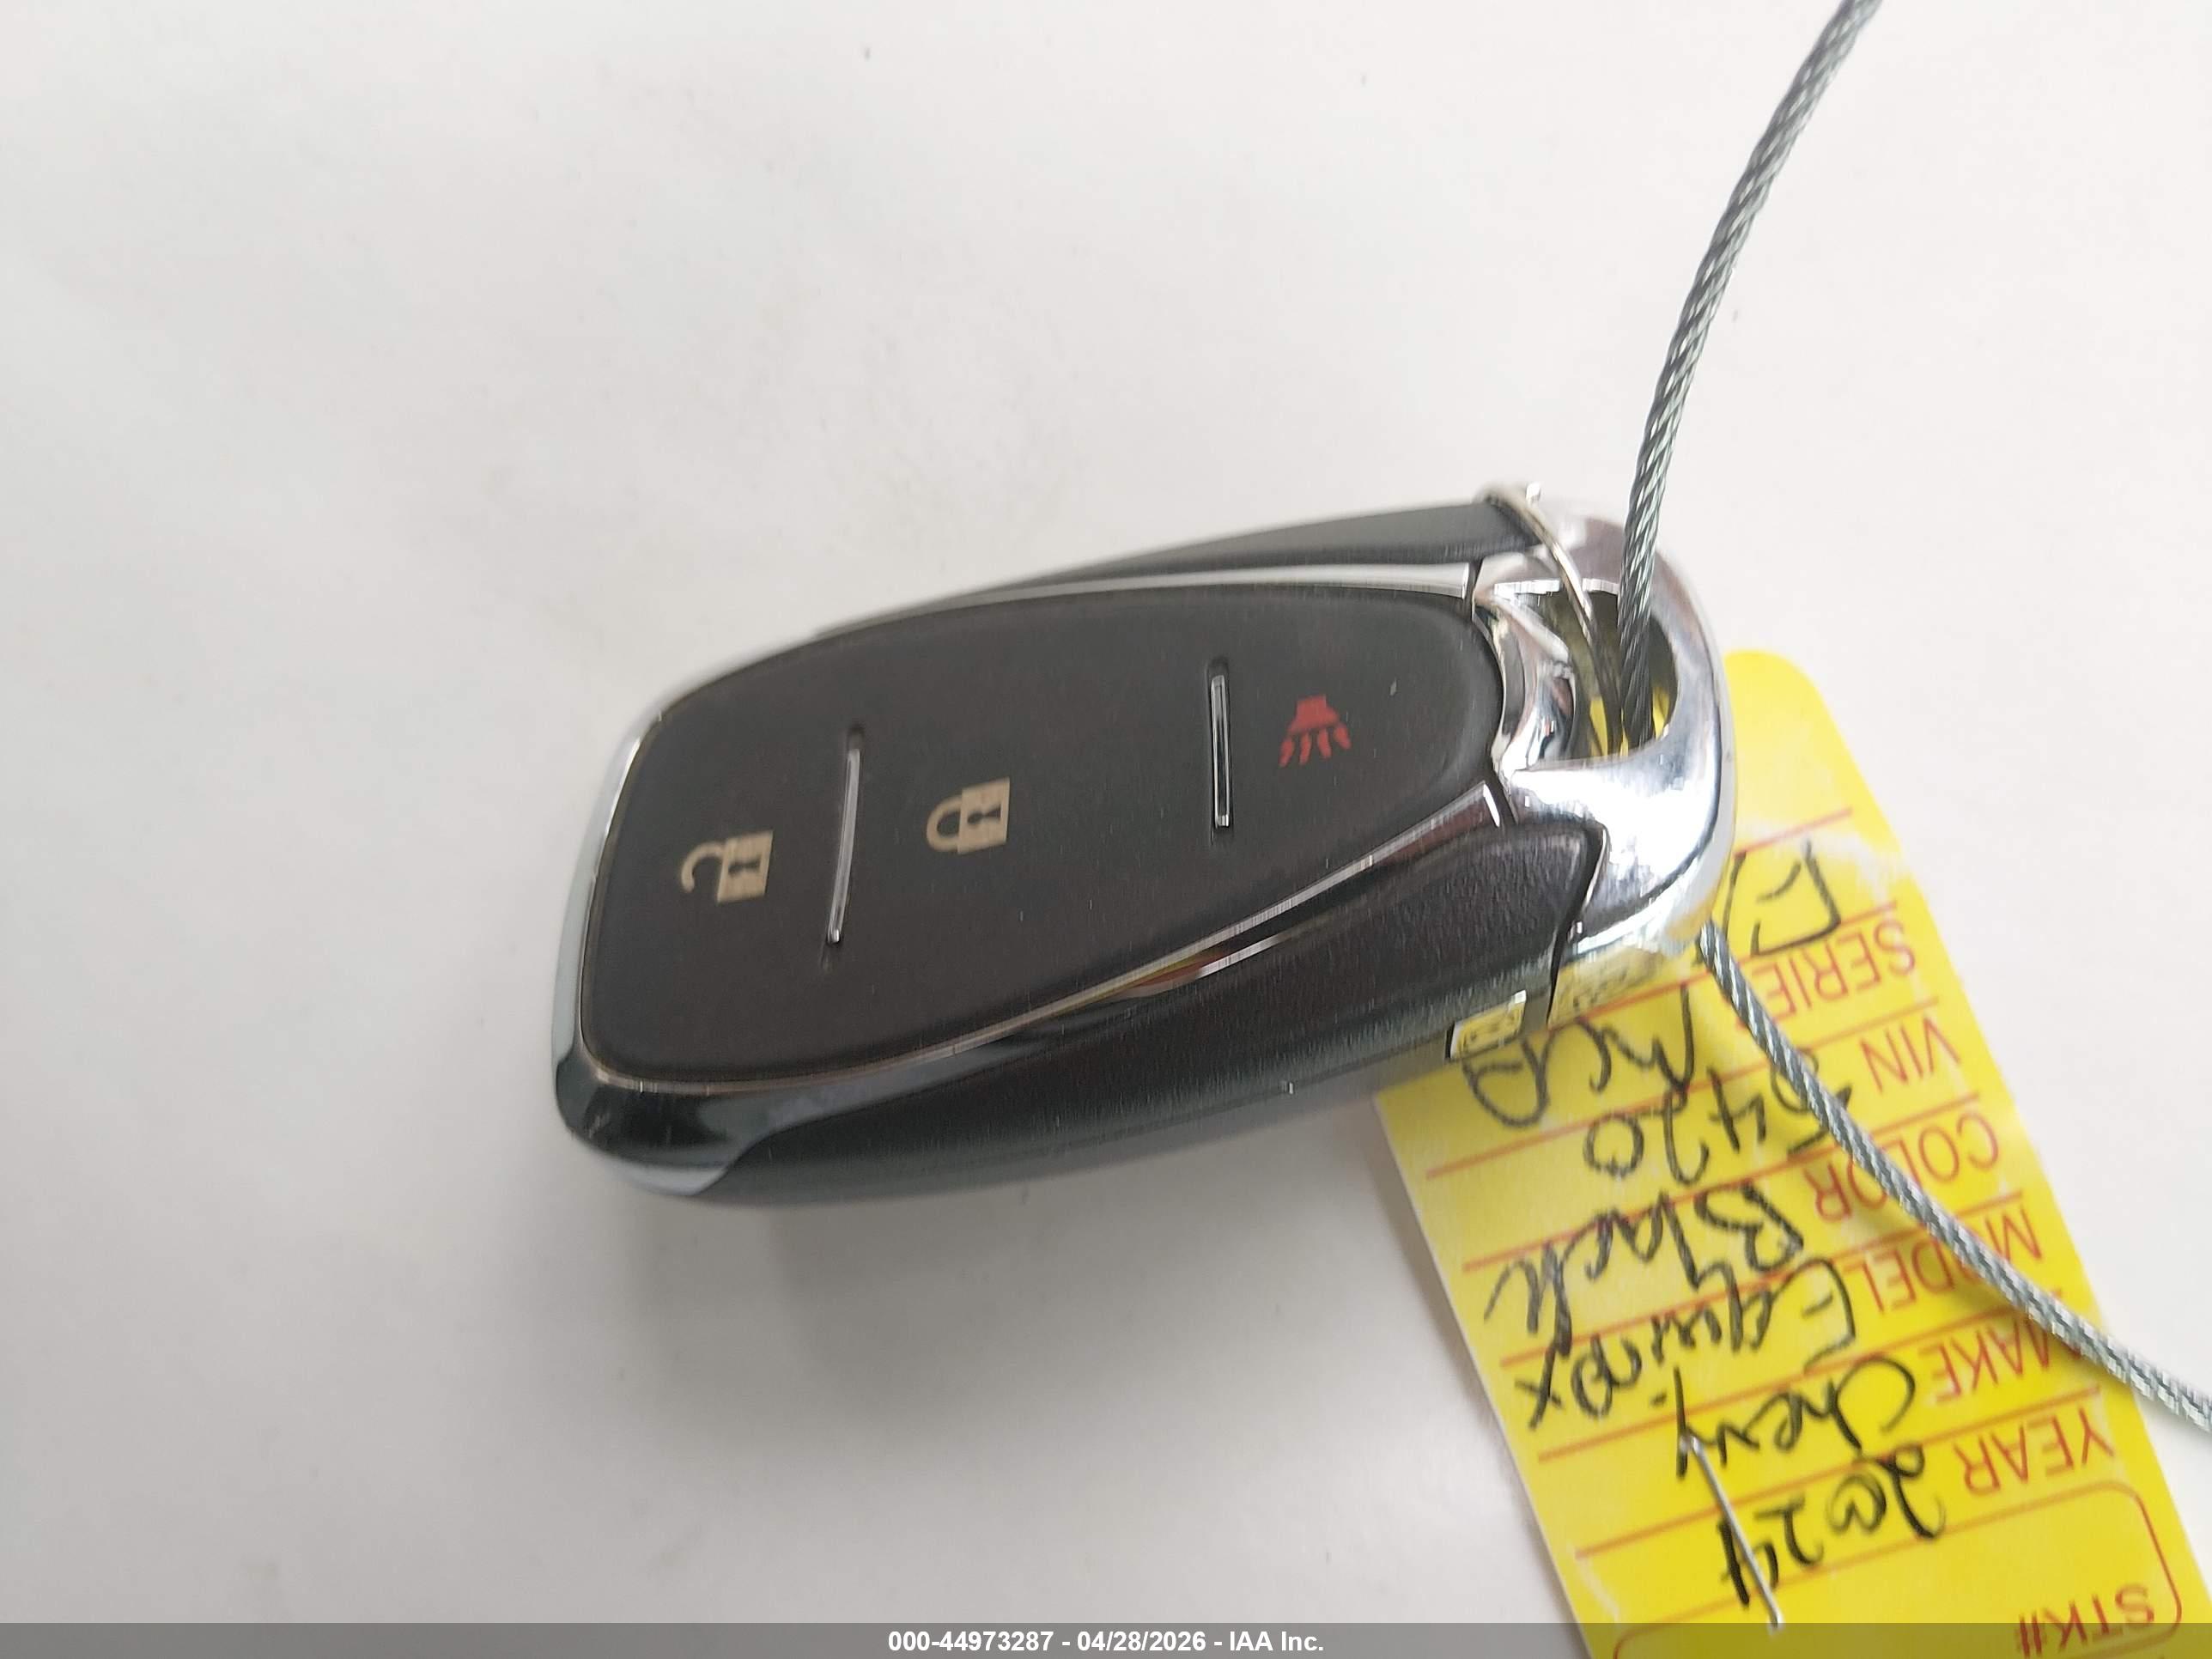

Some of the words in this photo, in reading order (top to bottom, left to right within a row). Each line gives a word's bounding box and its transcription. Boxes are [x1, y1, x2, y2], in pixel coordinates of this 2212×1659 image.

[1735, 919, 1917, 1030] SERIE
[1858, 1016, 1962, 1096] VIN
[1484, 1181, 1804, 1357] Black
[1673, 1356, 1915, 1478] Chevy
[1954, 1407, 2116, 1497] YEAR
[1719, 1444, 1946, 1608] 2024
[2014, 1584, 2155, 1658] STK#
